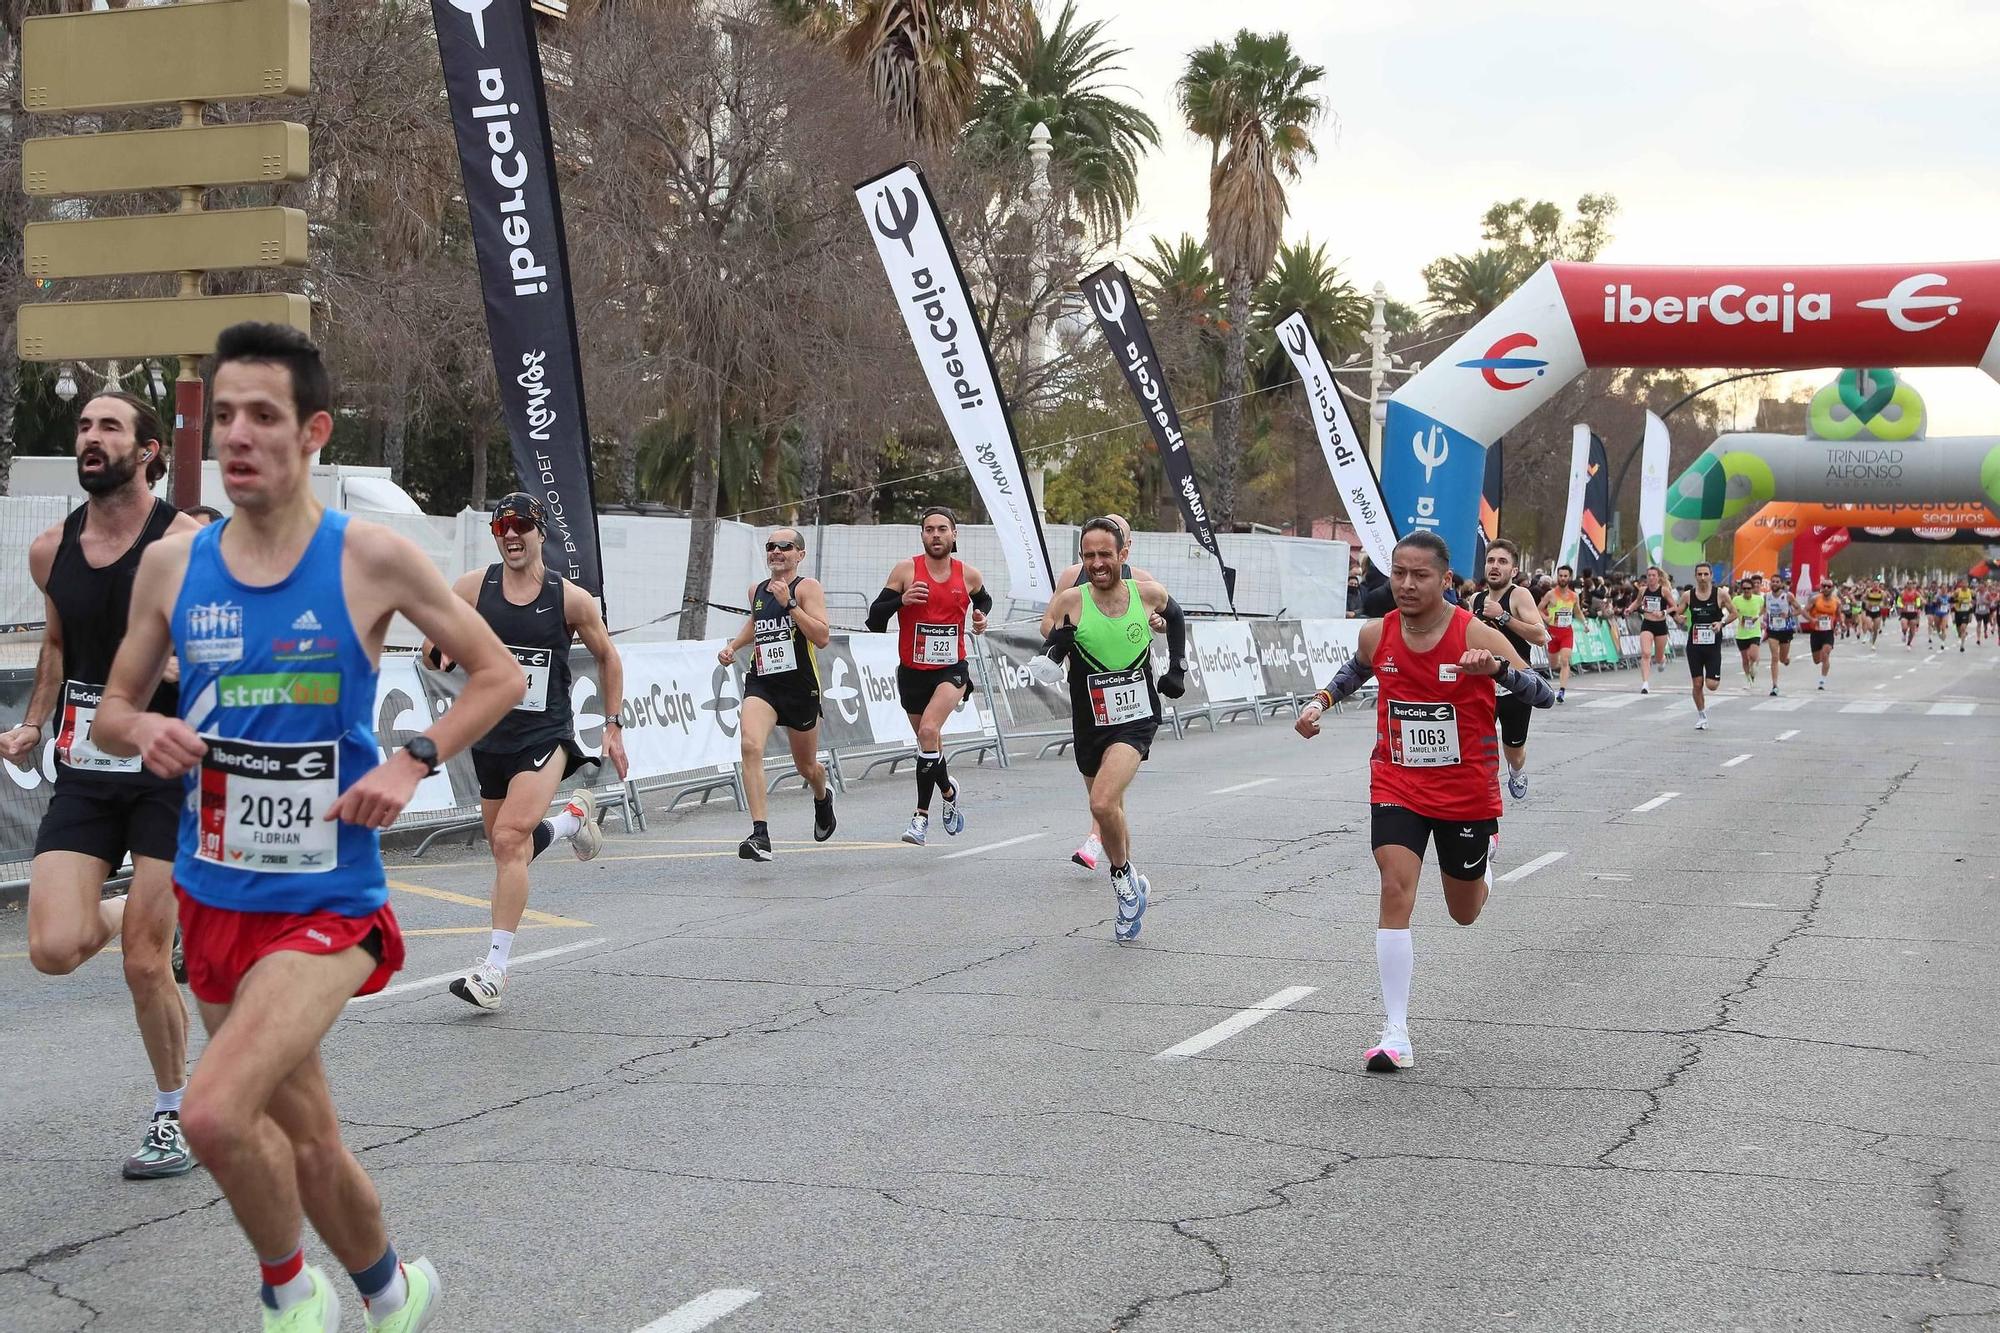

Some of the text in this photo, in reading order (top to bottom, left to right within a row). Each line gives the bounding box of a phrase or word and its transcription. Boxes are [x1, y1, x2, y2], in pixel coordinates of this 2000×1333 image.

[1604, 282, 1831, 333] iberCaja
[1826, 449, 1903, 464] TRINIDAD
[1826, 465, 1903, 479] ALFONSO
[1754, 515, 1797, 528] divina
[1922, 512, 1984, 525] seguros
[767, 647, 785, 659] 466
[933, 641, 950, 652] 523
[1200, 645, 1241, 677] iberCaja
[1095, 675, 1125, 686] iberCaja
[223, 675, 338, 707] struxbio
[1115, 689, 1136, 706] 517
[621, 680, 696, 736] berCaja
[1394, 706, 1427, 718] iberCaja
[1409, 729, 1446, 746] 1063
[212, 748, 280, 775] iberCaja
[240, 794, 314, 829] 2034
[253, 831, 301, 844] FLORIAN
